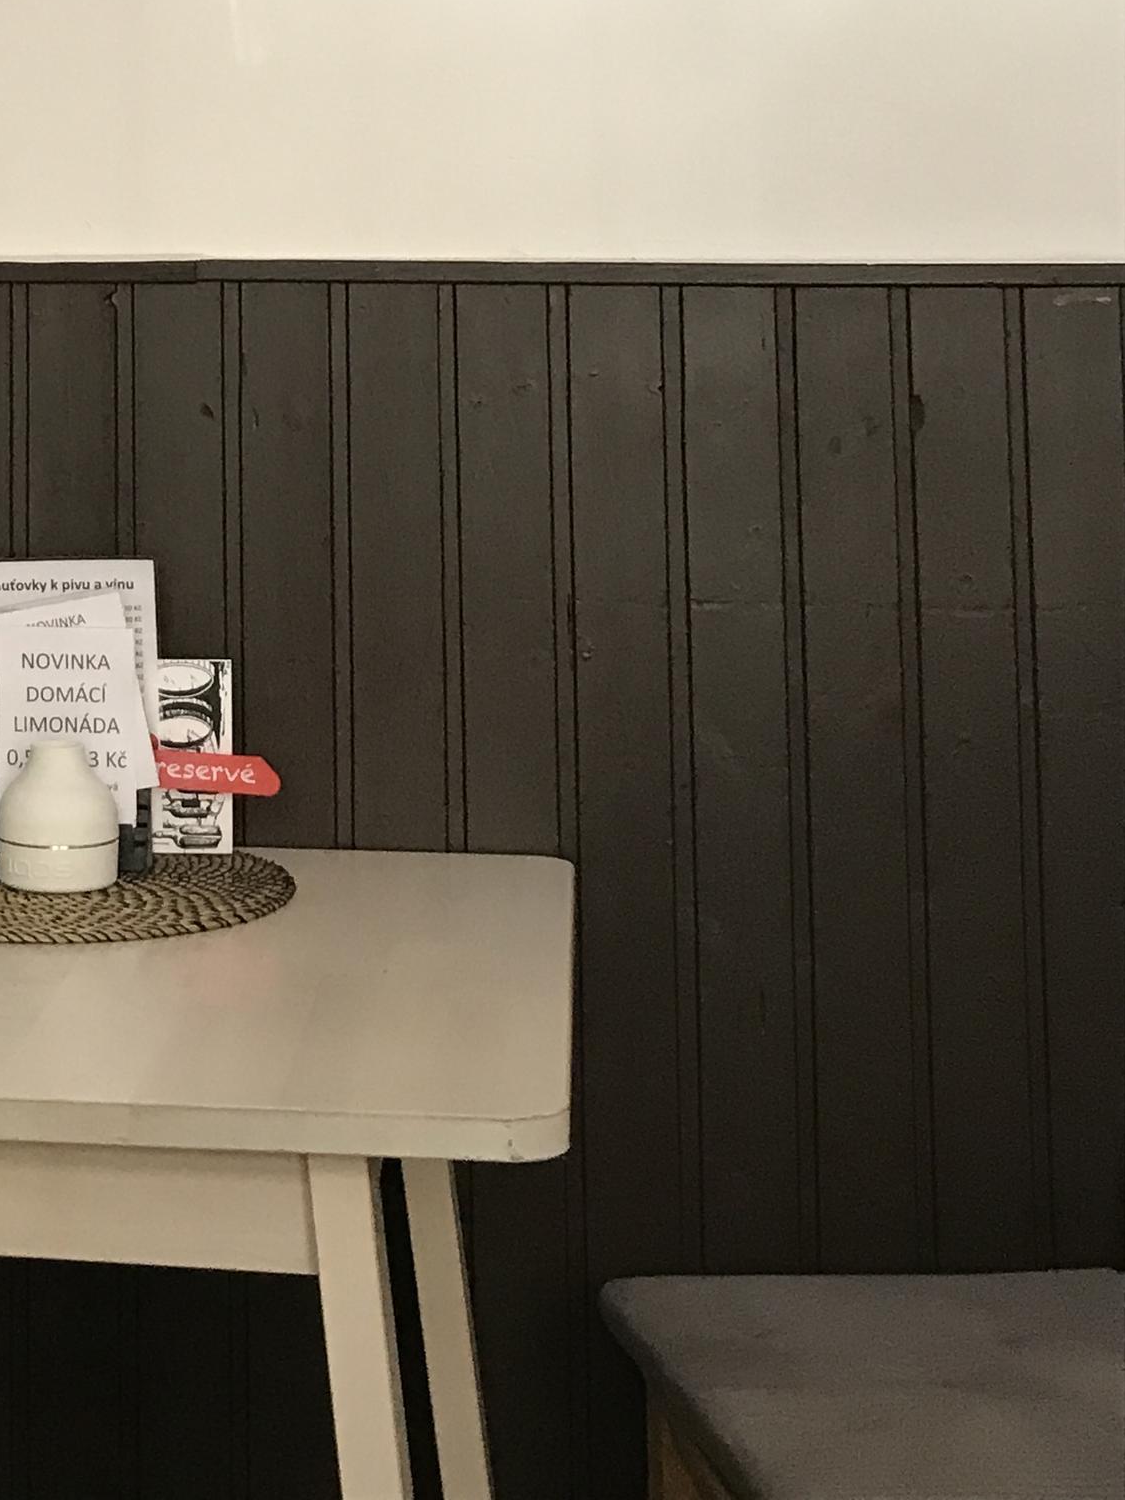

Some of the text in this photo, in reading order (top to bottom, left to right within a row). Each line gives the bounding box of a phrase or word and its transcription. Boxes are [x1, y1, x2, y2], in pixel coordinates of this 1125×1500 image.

[50, 578, 58, 590] k
[62, 578, 90, 593] pivu
[94, 581, 102, 590] a
[21, 652, 111, 670] NOVINKA
[25, 682, 107, 703] DOMÁCÍ
[14, 712, 120, 734] LIMONÁDA
[105, 750, 127, 769] Kč
